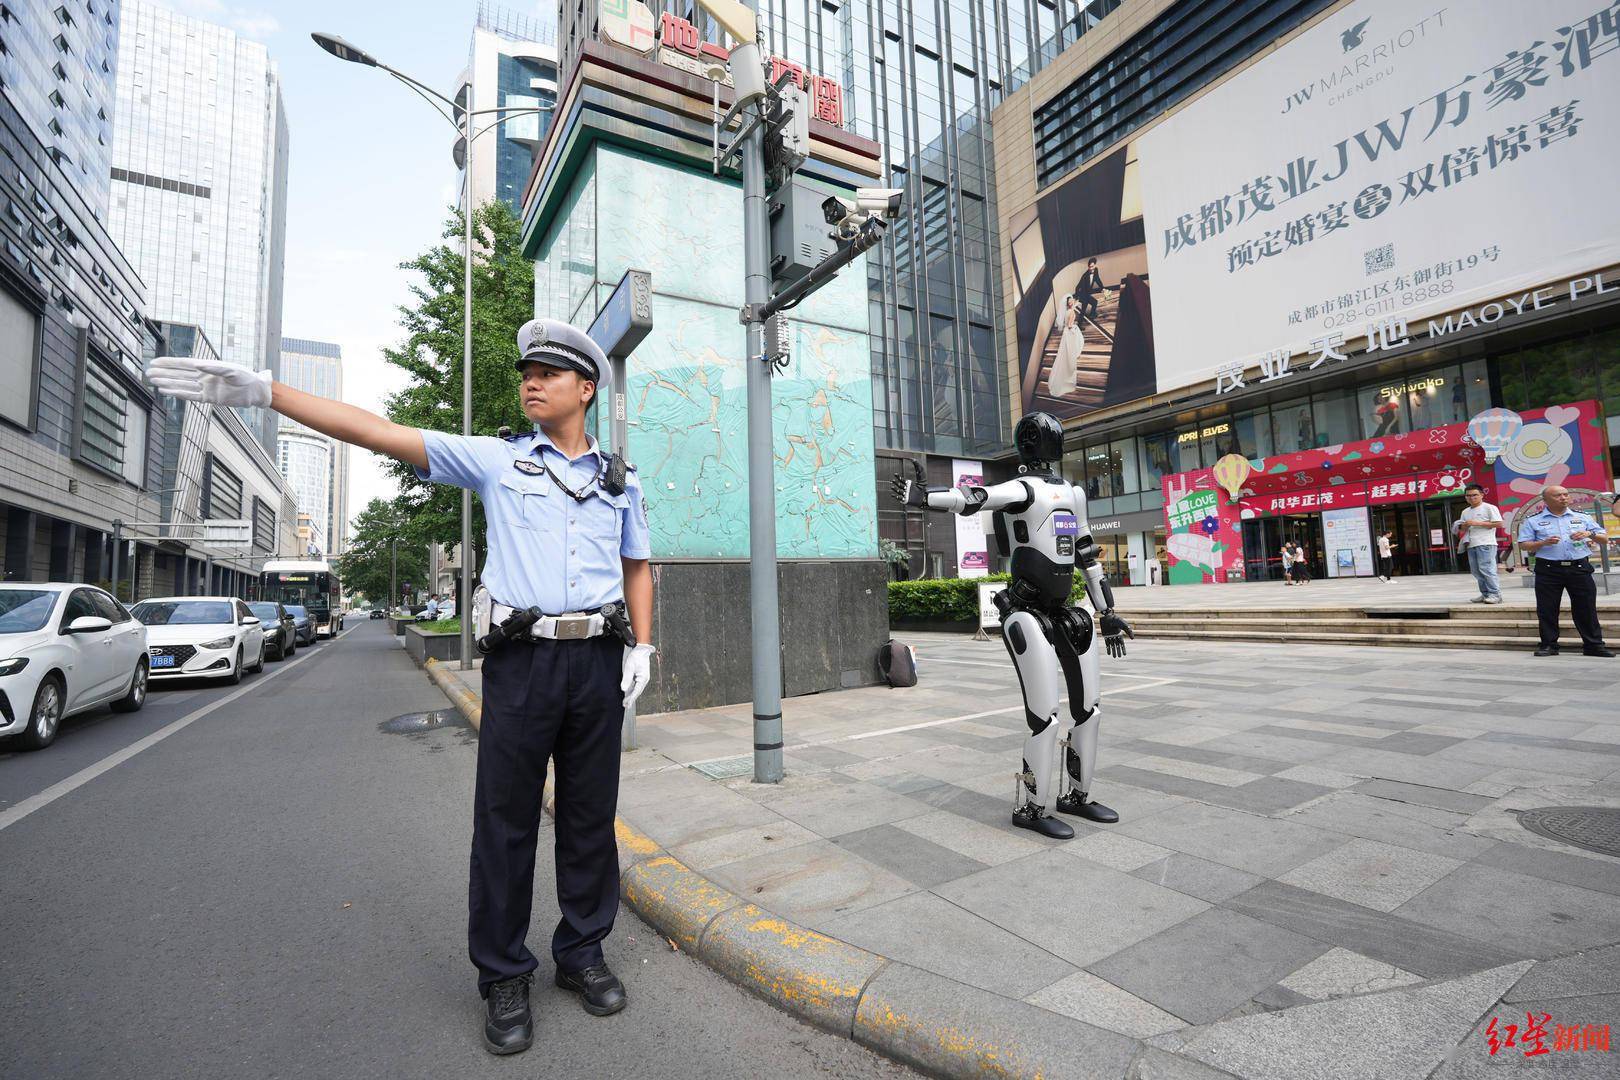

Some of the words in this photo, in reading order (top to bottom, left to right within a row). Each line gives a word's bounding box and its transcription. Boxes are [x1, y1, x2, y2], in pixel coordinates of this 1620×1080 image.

[1281, 84, 1315, 114] JW
[1320, 8, 1448, 92] MARRIOTT
[1328, 65, 1394, 106] CHENGDU
[1288, 245, 1501, 327] 成都市锦江区东御街19号
[1324, 297, 1395, 329] 028-6111
[1402, 280, 1454, 306] 8888
[1215, 315, 1409, 395] 茂业天地
[1428, 286, 1554, 339] MAOYE
[1203, 424, 1229, 437] ELVES
[1090, 521, 1121, 531] HUAWEI
